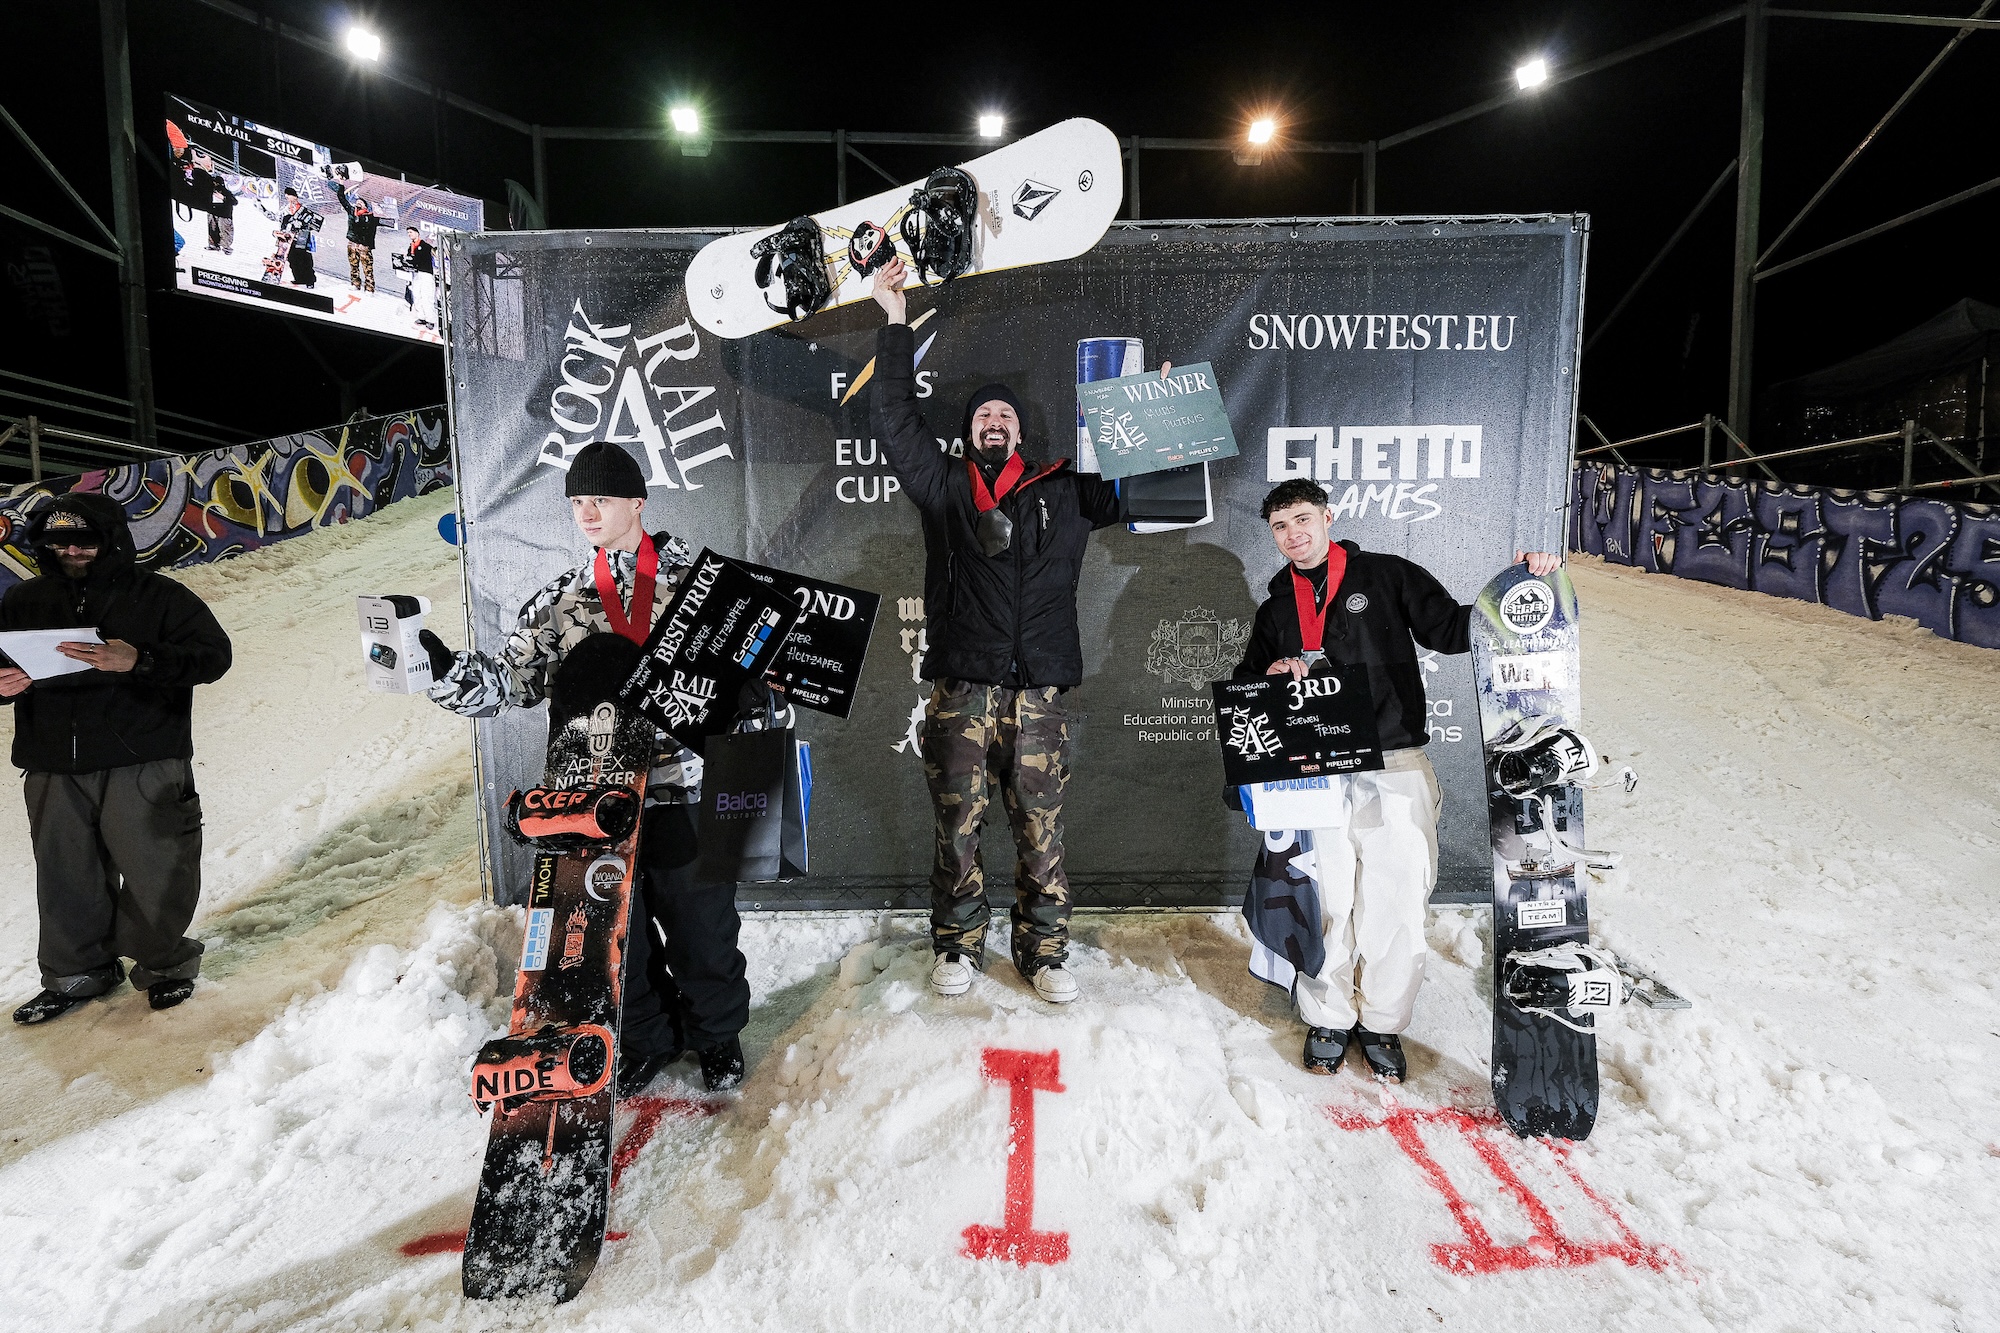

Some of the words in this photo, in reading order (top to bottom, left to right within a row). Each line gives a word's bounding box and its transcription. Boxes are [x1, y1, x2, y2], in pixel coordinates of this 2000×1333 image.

[187, 114, 212, 130] ROCK
[212, 121, 225, 135] A
[224, 125, 251, 142] RAIL
[416, 200, 469, 221] SNOWFEST.EU
[198, 270, 249, 288] PRIZE-GIVING
[1249, 313, 1518, 351] SNOWFEST.EU
[536, 298, 632, 472] ROCK
[1122, 372, 1213, 404] WINNER
[633, 317, 735, 491] RAIL
[605, 365, 680, 489] A
[1097, 405, 1116, 445] ROCK
[1110, 420, 1136, 450] A
[1117, 411, 1149, 450] RAIL
[1267, 424, 1482, 482] GHETTO
[835, 476, 901, 503] CUP
[654, 614, 690, 666] BEST
[678, 556, 725, 617] TRICK
[794, 586, 856, 624] 2ND
[1506, 603, 1549, 614] SHRED
[1512, 613, 1541, 622] MASTERS
[367, 616, 389, 630] 13
[732, 606, 772, 663] GoPro
[685, 624, 713, 661] CASPER
[787, 646, 844, 673] HOLTZAPFEL
[670, 669, 717, 699] RAIL
[792, 687, 820, 701] PIPELIFE
[1286, 675, 1342, 711] 3RD
[648, 679, 687, 729] ROCK
[672, 690, 709, 726] A
[695, 707, 710, 724] 2025
[1161, 696, 1214, 711] Ministry
[1123, 713, 1187, 726] Education
[1191, 712, 1215, 725] and
[1226, 705, 1251, 749] ROCK
[1251, 711, 1284, 757] RAIL
[1138, 729, 1194, 743] Republic
[1197, 728, 1212, 741] of
[1239, 722, 1267, 754] A
[565, 754, 626, 774] APHEX
[1246, 753, 1260, 762] 2025
[1326, 759, 1354, 768] PIPELIFE
[555, 771, 636, 791] NIDECKER
[715, 810, 767, 820] insurance
[716, 791, 767, 811] Balcia
[536, 858, 553, 903] HOWL
[1528, 913, 1557, 921] TEAM
[533, 911, 550, 968] GoPro
[476, 1068, 553, 1098] NIDE
[960, 1048, 1070, 1268] I
